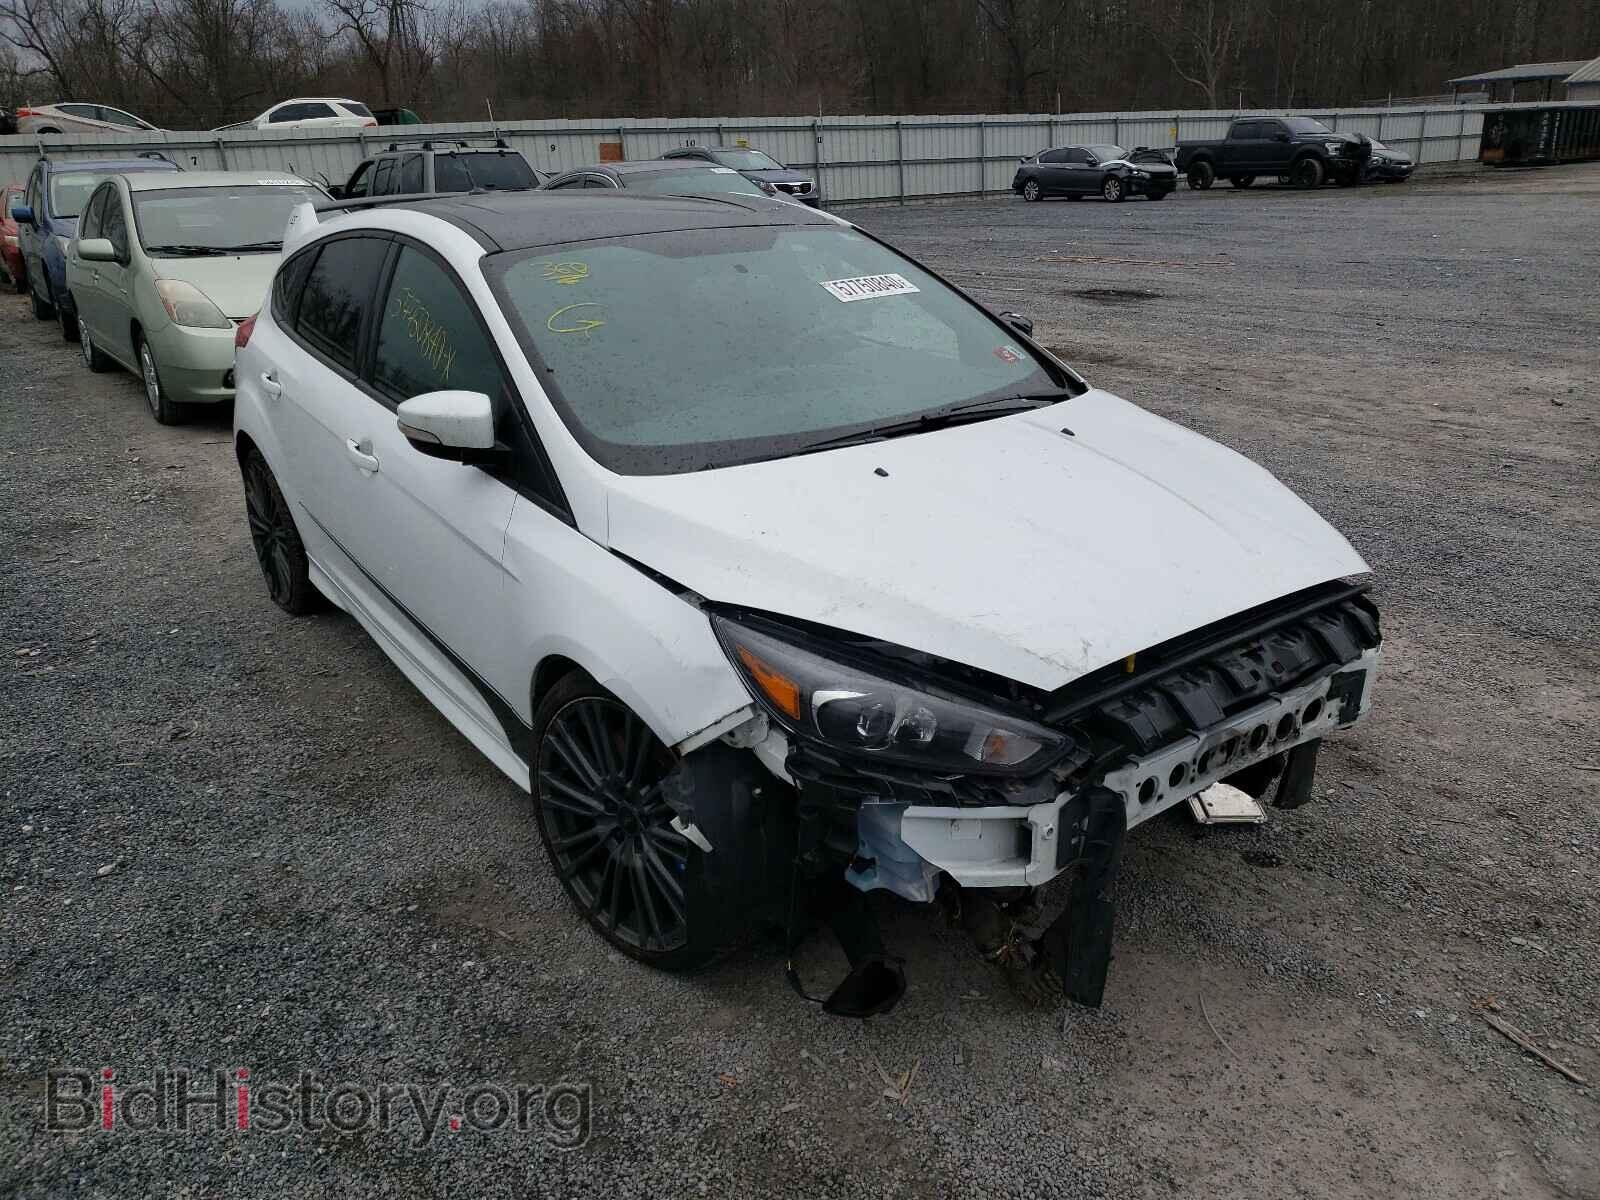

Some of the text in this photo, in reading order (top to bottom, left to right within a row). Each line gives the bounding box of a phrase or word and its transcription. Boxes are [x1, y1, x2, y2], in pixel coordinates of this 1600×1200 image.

[550, 143, 557, 152] 9
[190, 156, 198, 166] 7
[547, 302, 607, 335] G
